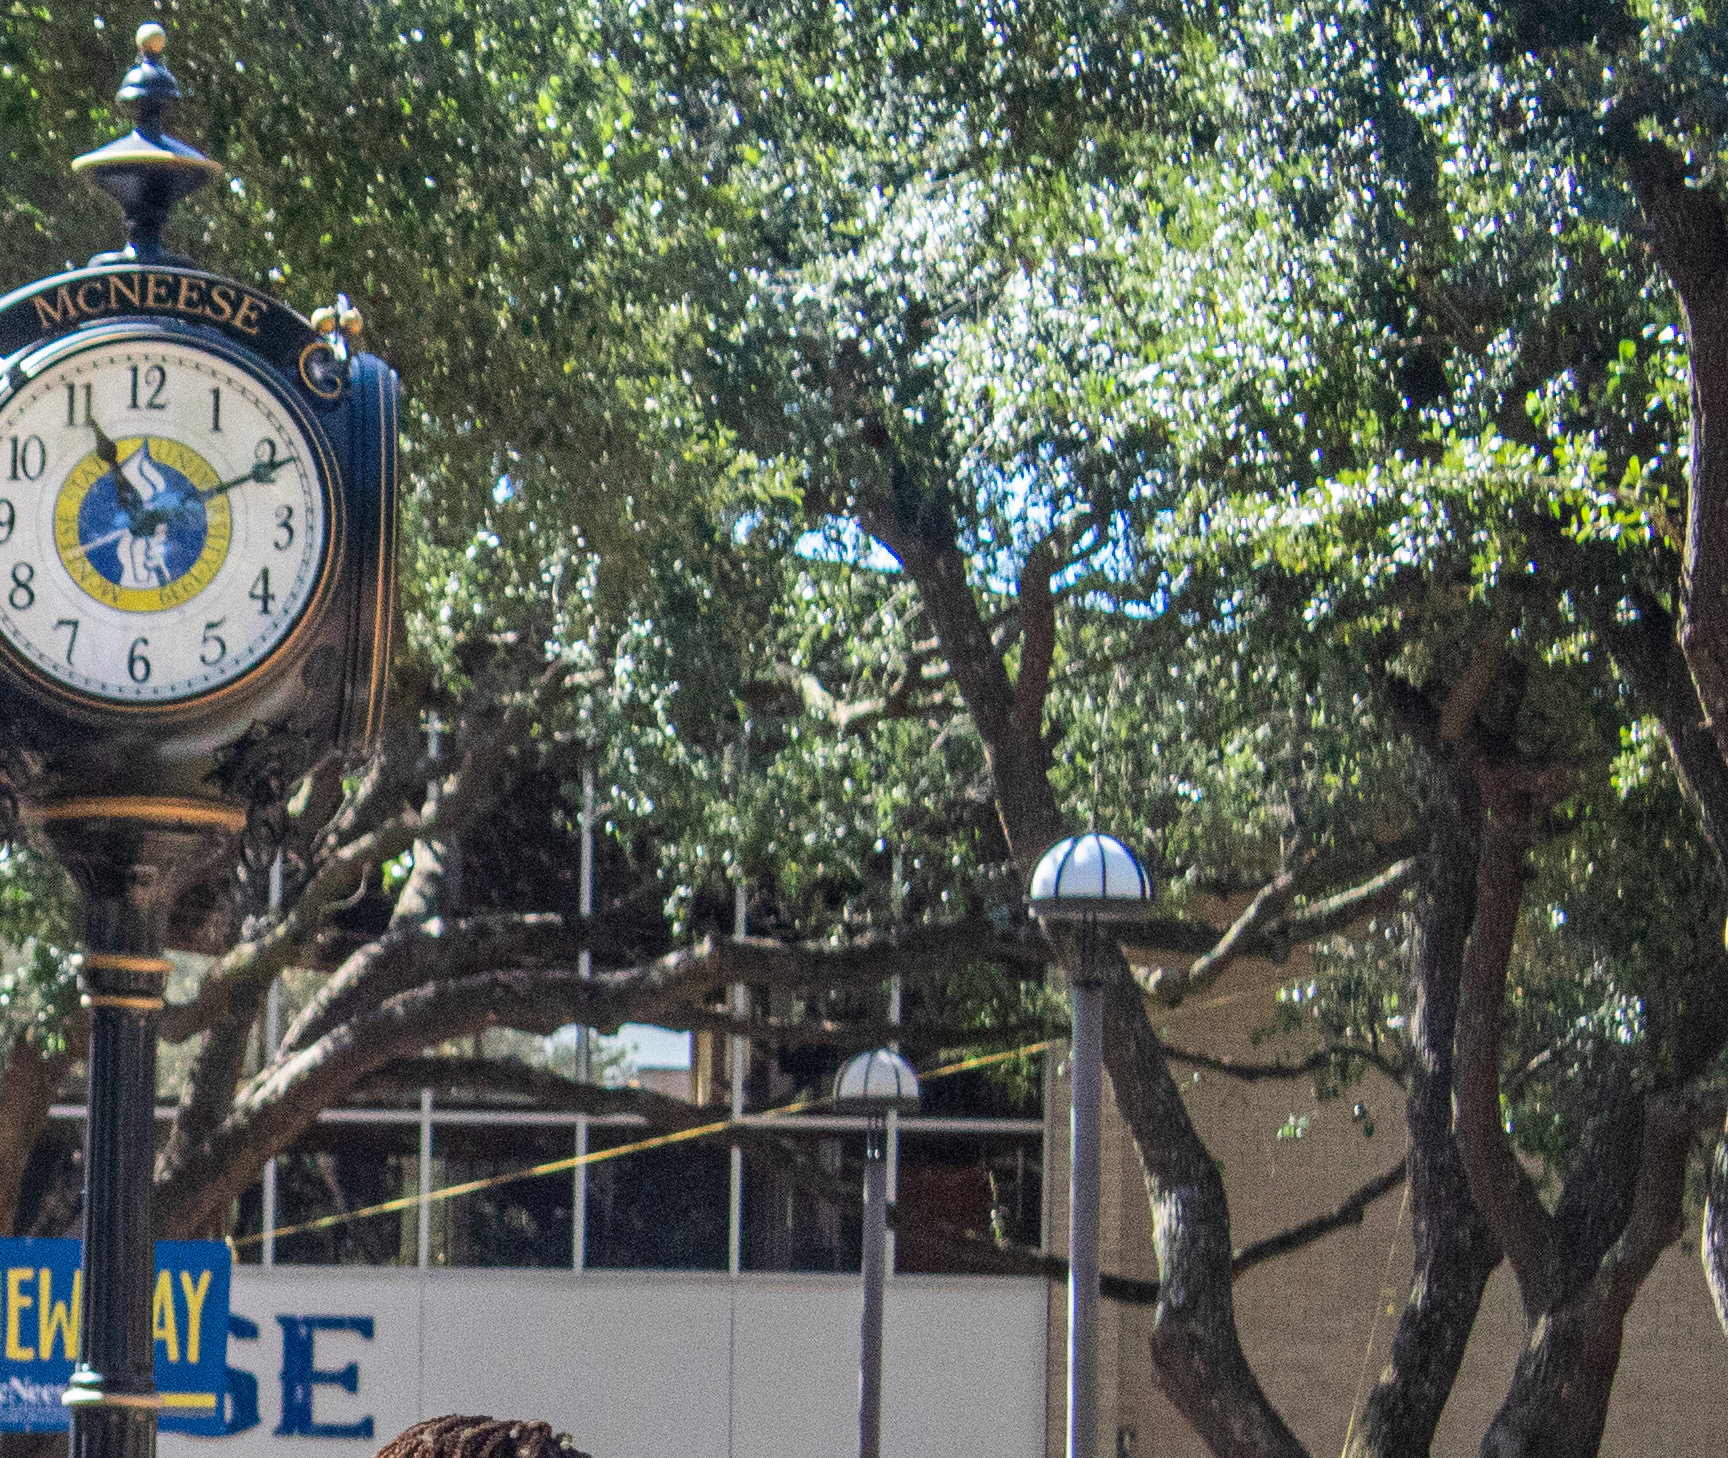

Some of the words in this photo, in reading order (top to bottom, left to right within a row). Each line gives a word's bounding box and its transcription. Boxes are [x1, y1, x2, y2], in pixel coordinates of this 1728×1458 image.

[66, 382, 93, 428] 11
[126, 364, 168, 409] 12
[208, 387, 223, 432] 1
[8, 434, 46, 481] 10
[273, 505, 294, 551] 3
[8, 561, 36, 610] 8
[248, 567, 275, 615] 4
[53, 619, 80, 666] 7
[127, 636, 151, 683] 6
[199, 617, 227, 666] 5
[153, 1268, 213, 1364] AY
